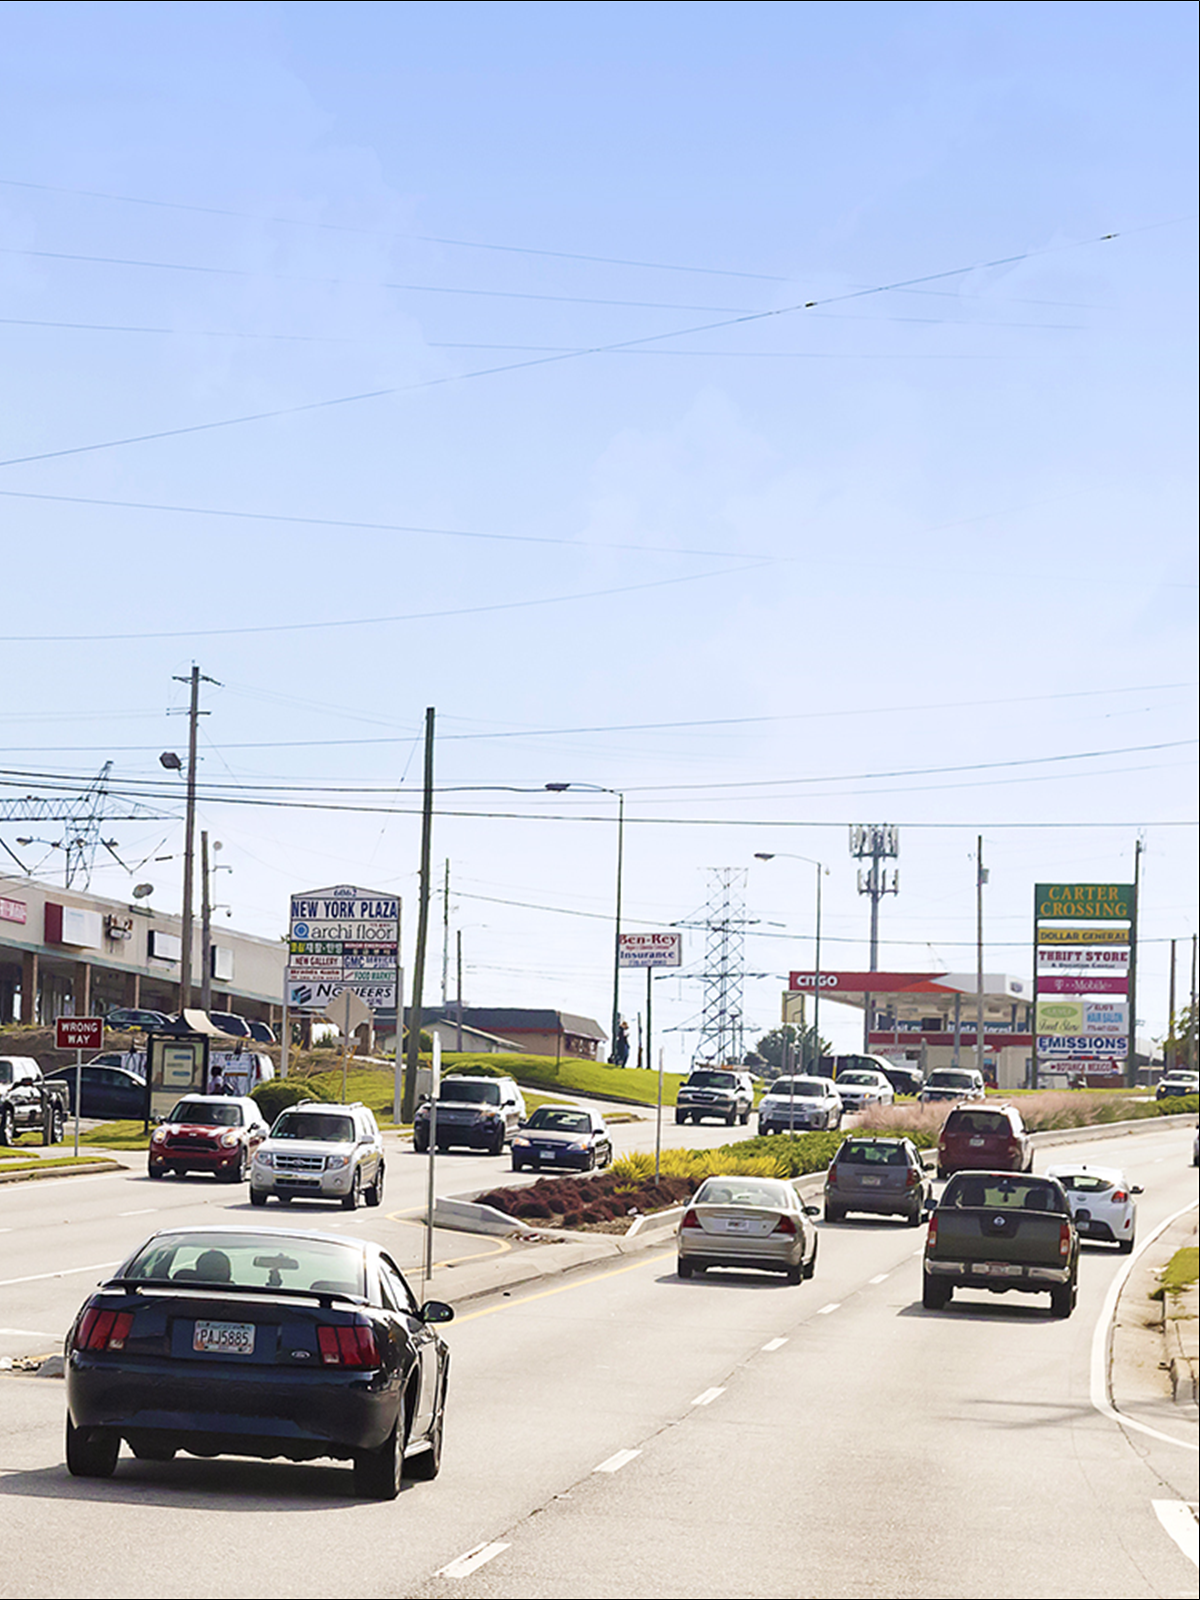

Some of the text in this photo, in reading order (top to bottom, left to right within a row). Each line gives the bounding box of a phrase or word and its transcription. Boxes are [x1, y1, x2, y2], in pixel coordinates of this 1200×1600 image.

[1048, 886, 1119, 900] CARTER
[291, 901, 398, 918] NEW YORK PLAZA
[1040, 902, 1127, 917] CROSSING
[311, 924, 393, 939] archi floor
[1040, 932, 1127, 940] DOLLAR GENERAL
[620, 951, 675, 959] Insurance
[1039, 951, 1128, 961] THRIFT STORE
[797, 975, 838, 986] CITGO
[316, 984, 392, 998] NGNEERS
[61, 1021, 98, 1032] WRONG
[67, 1034, 90, 1044] WAY
[1038, 1037, 1127, 1049] EMISSIONS
